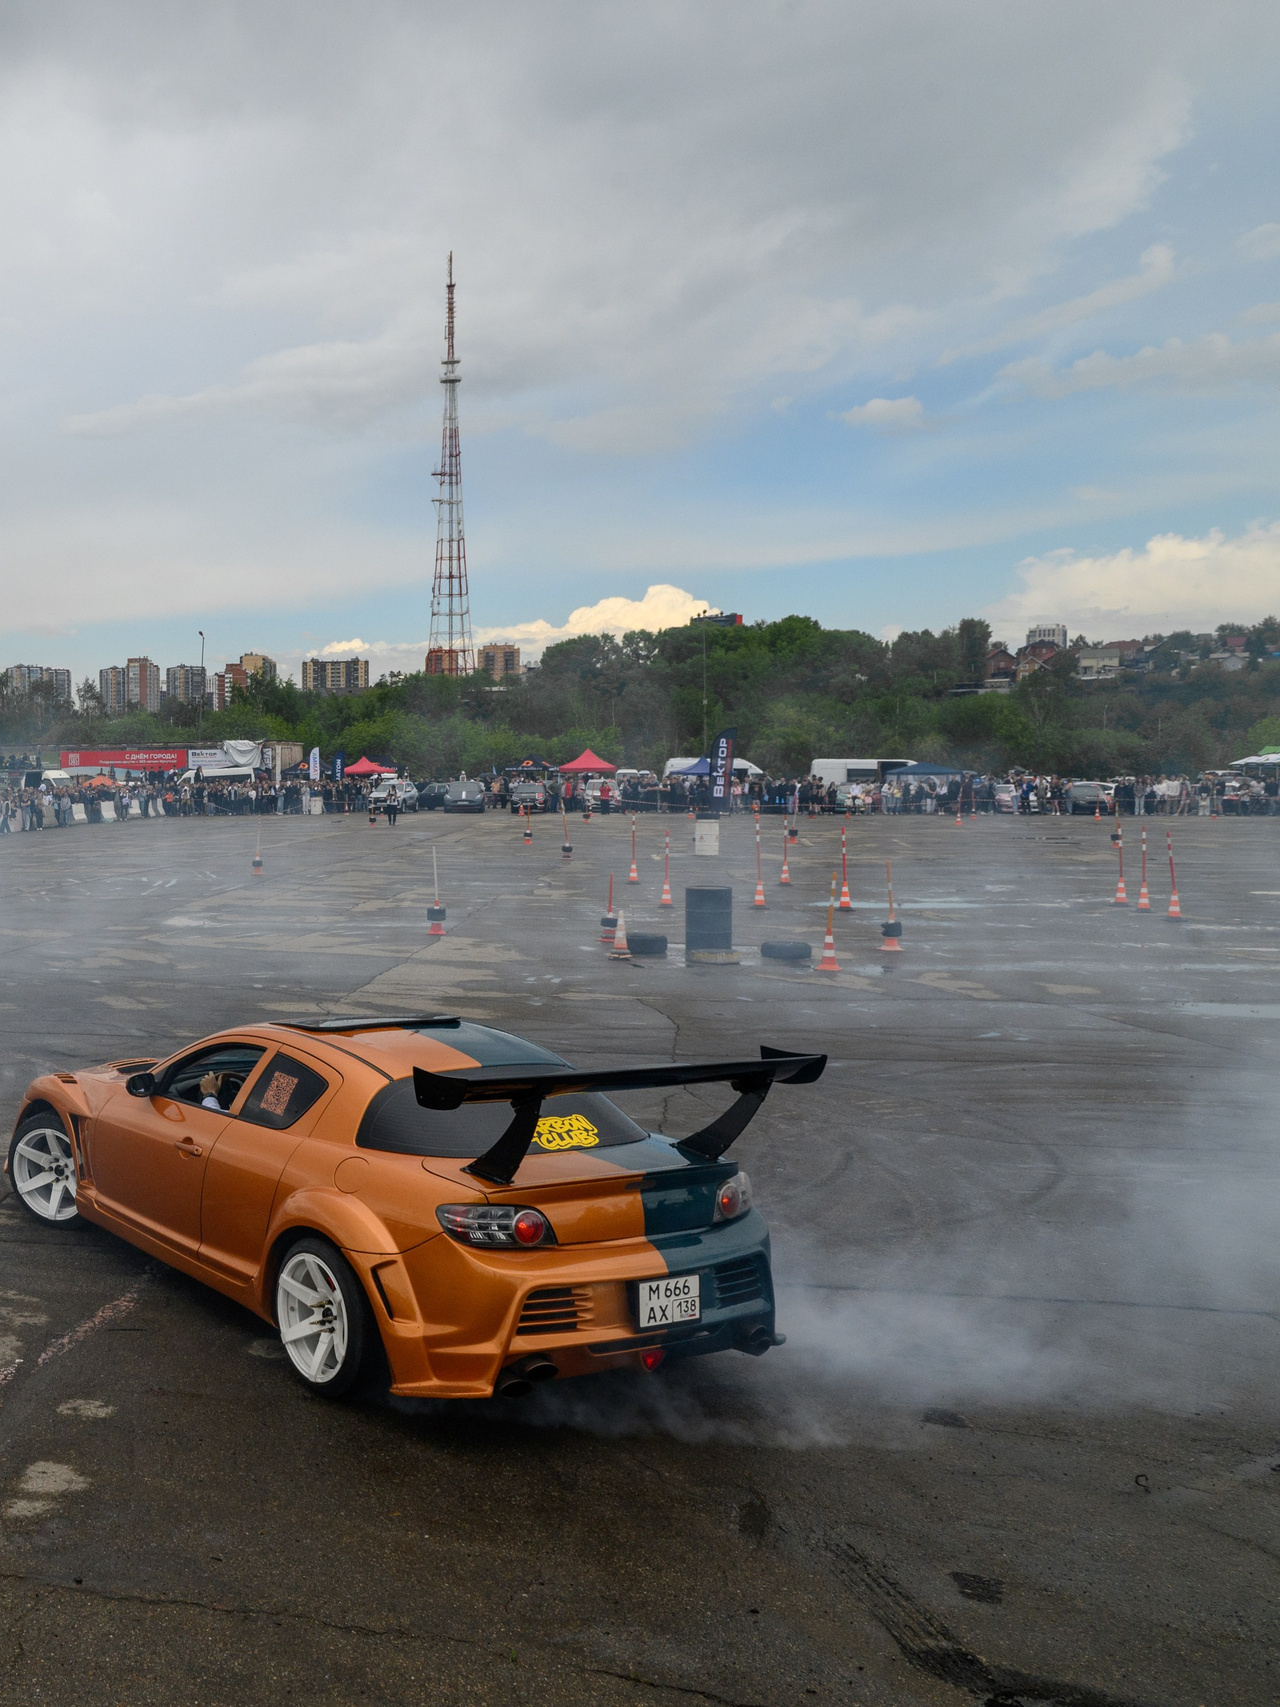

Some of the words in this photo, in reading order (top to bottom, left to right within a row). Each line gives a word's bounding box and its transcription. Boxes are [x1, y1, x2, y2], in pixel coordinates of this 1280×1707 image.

[539, 1130, 599, 1150] CLUB
[664, 1279, 690, 1298] 666
[676, 1299, 697, 1314] 138
